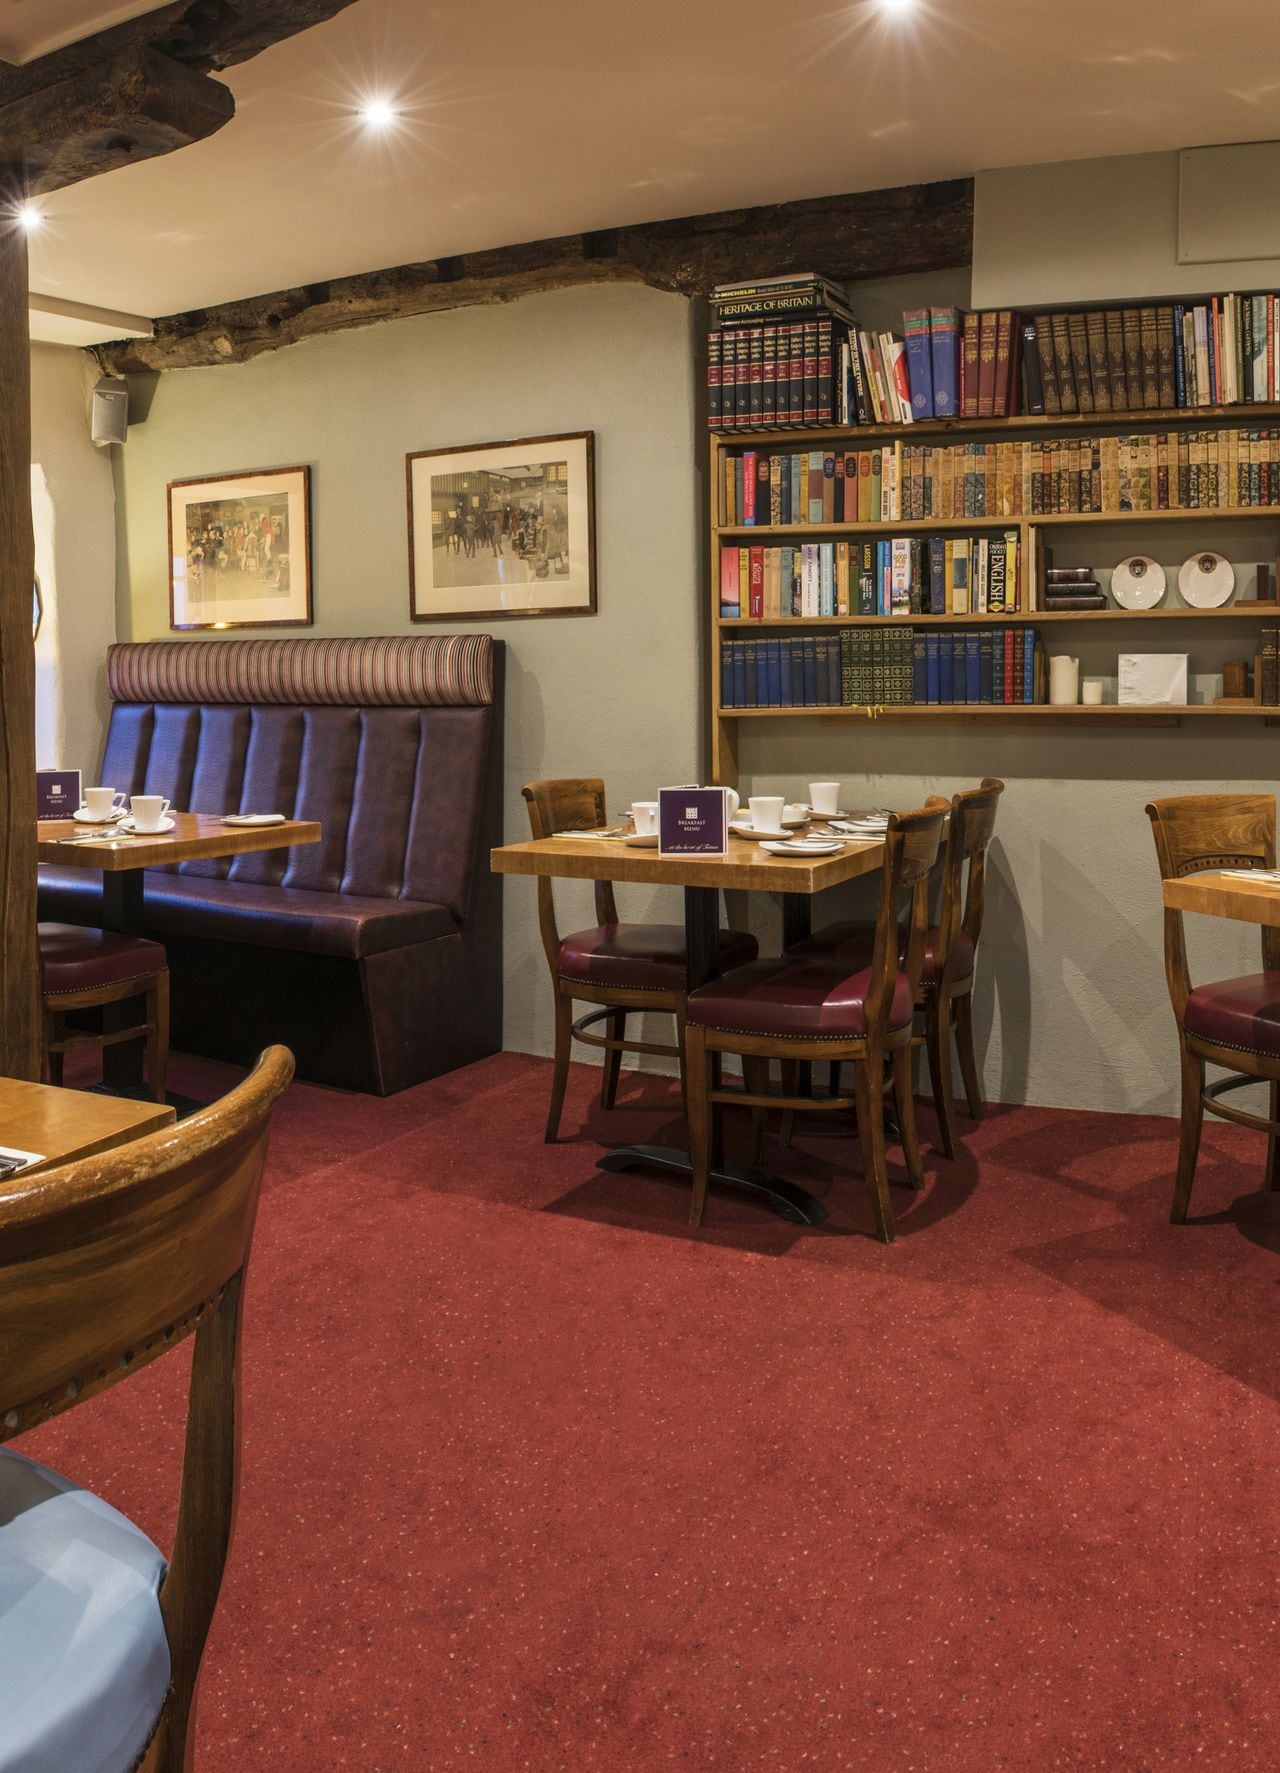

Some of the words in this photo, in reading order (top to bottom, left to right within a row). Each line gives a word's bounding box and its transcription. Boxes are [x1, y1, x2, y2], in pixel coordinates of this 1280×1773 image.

[719, 302, 763, 315] HERITAGE
[763, 301, 775, 310] OF
[777, 295, 813, 308] BRITAIN
[990, 555, 1005, 601] ENGLISH
